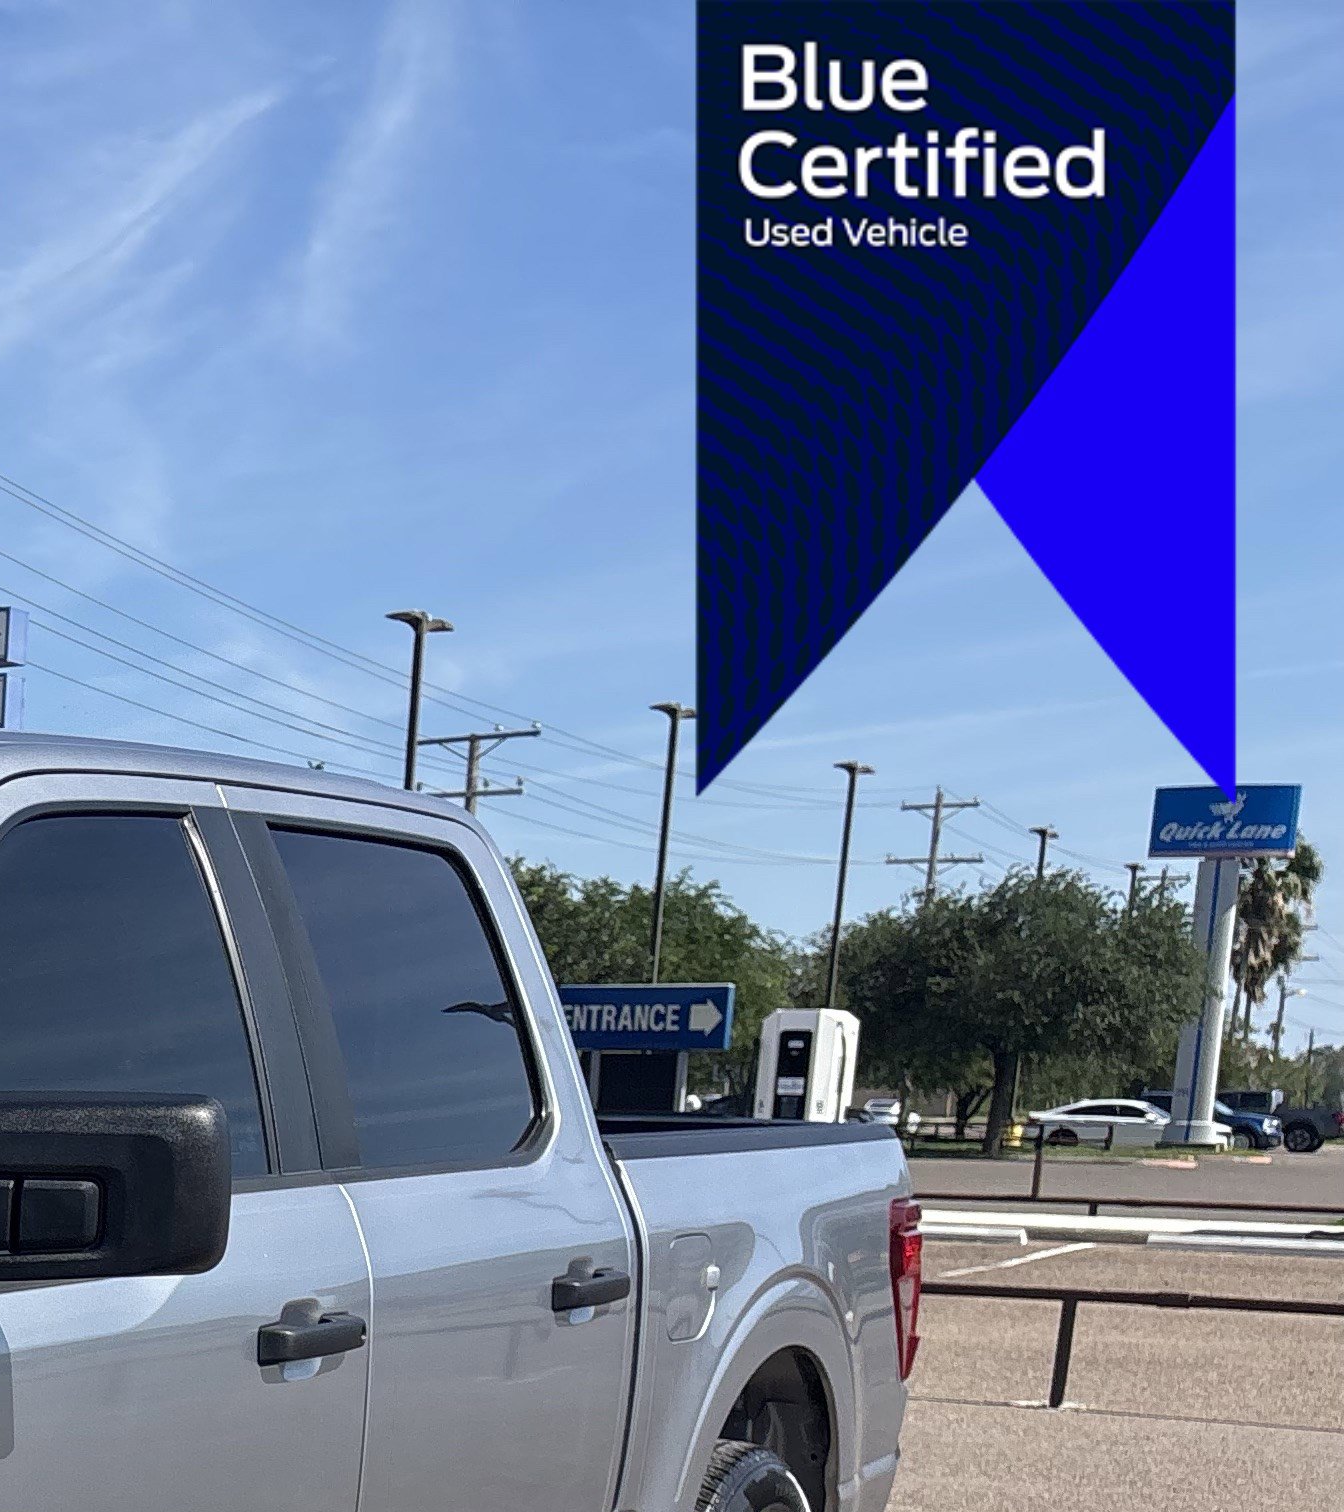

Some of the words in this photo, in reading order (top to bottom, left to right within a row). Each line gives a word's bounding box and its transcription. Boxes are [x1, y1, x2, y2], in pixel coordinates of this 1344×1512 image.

[1159, 820, 1226, 842] Quick
[1226, 820, 1287, 840] Lane
[562, 1003, 681, 1032] ENTRANCE
